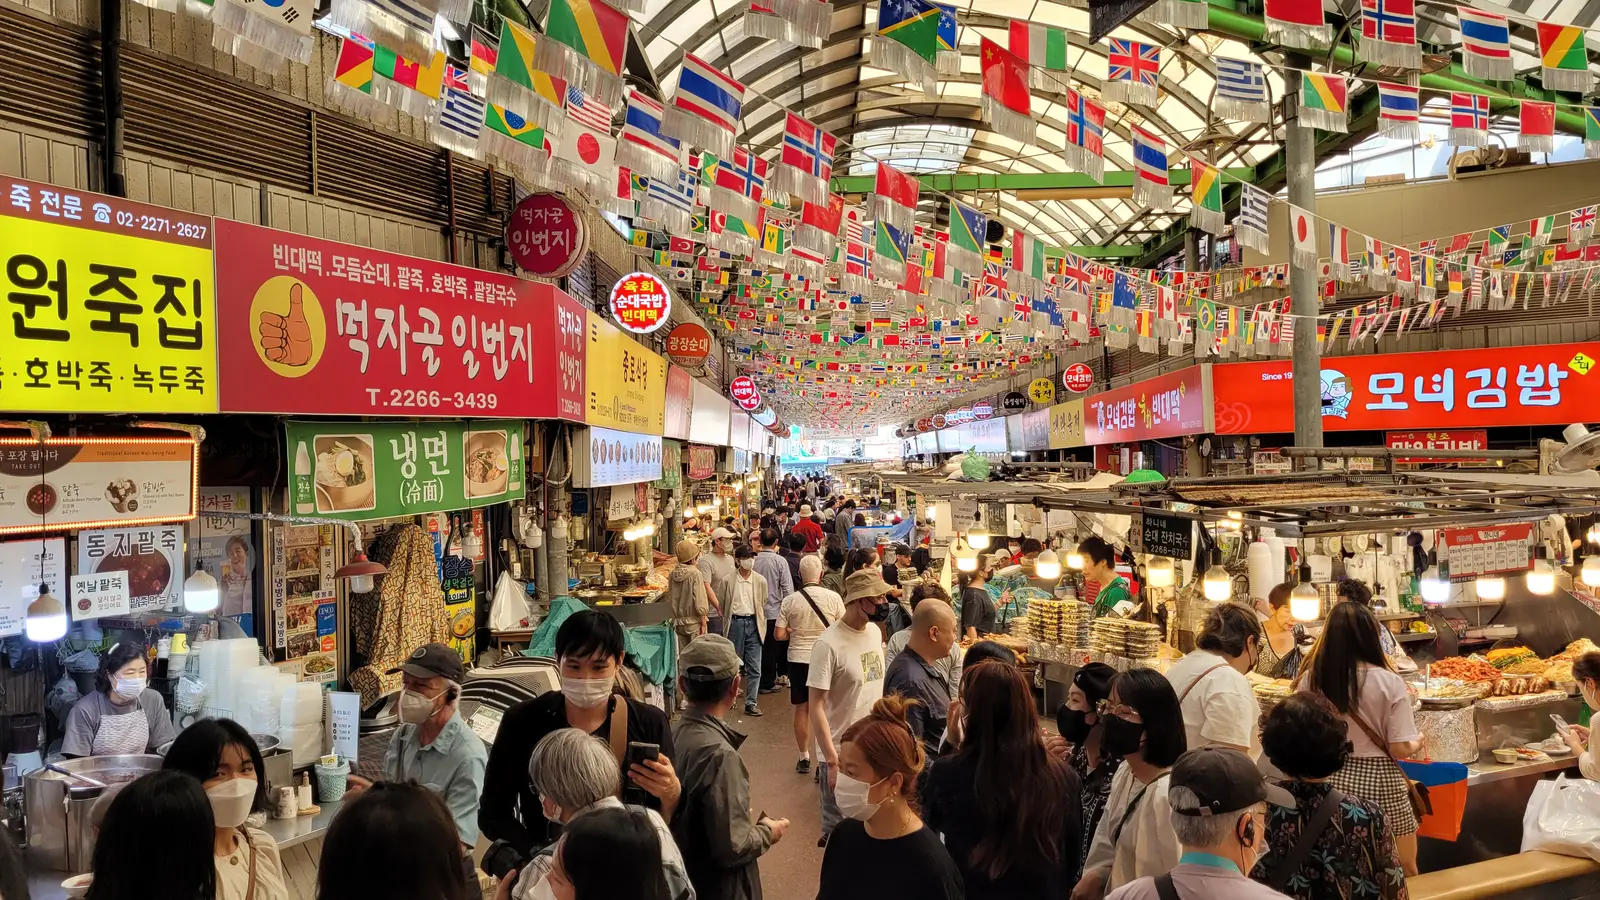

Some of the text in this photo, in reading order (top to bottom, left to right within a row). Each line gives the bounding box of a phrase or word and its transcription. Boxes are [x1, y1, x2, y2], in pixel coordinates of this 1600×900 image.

[39, 189, 83, 220] 전문
[116, 211, 207, 240] 02-2271-2627
[512, 228, 570, 257] 일번지
[623, 280, 655, 293] 육회
[615, 293, 664, 309] 순대국밥
[622, 309, 658, 322] 빈대떡
[670, 336, 709, 352] 광장순대
[1261, 372, 1283, 381] Since
[1152, 388, 1181, 425] 빈대떡
[7, 450, 60, 462] 포장 됩니다
[389, 430, 450, 479] 냉면
[1132, 529, 1141, 537] 64
[1144, 528, 1190, 547] 순대 잔치국수
[76, 578, 122, 594] 옛날 팥죽
[275, 578, 284, 608] 냉방중
